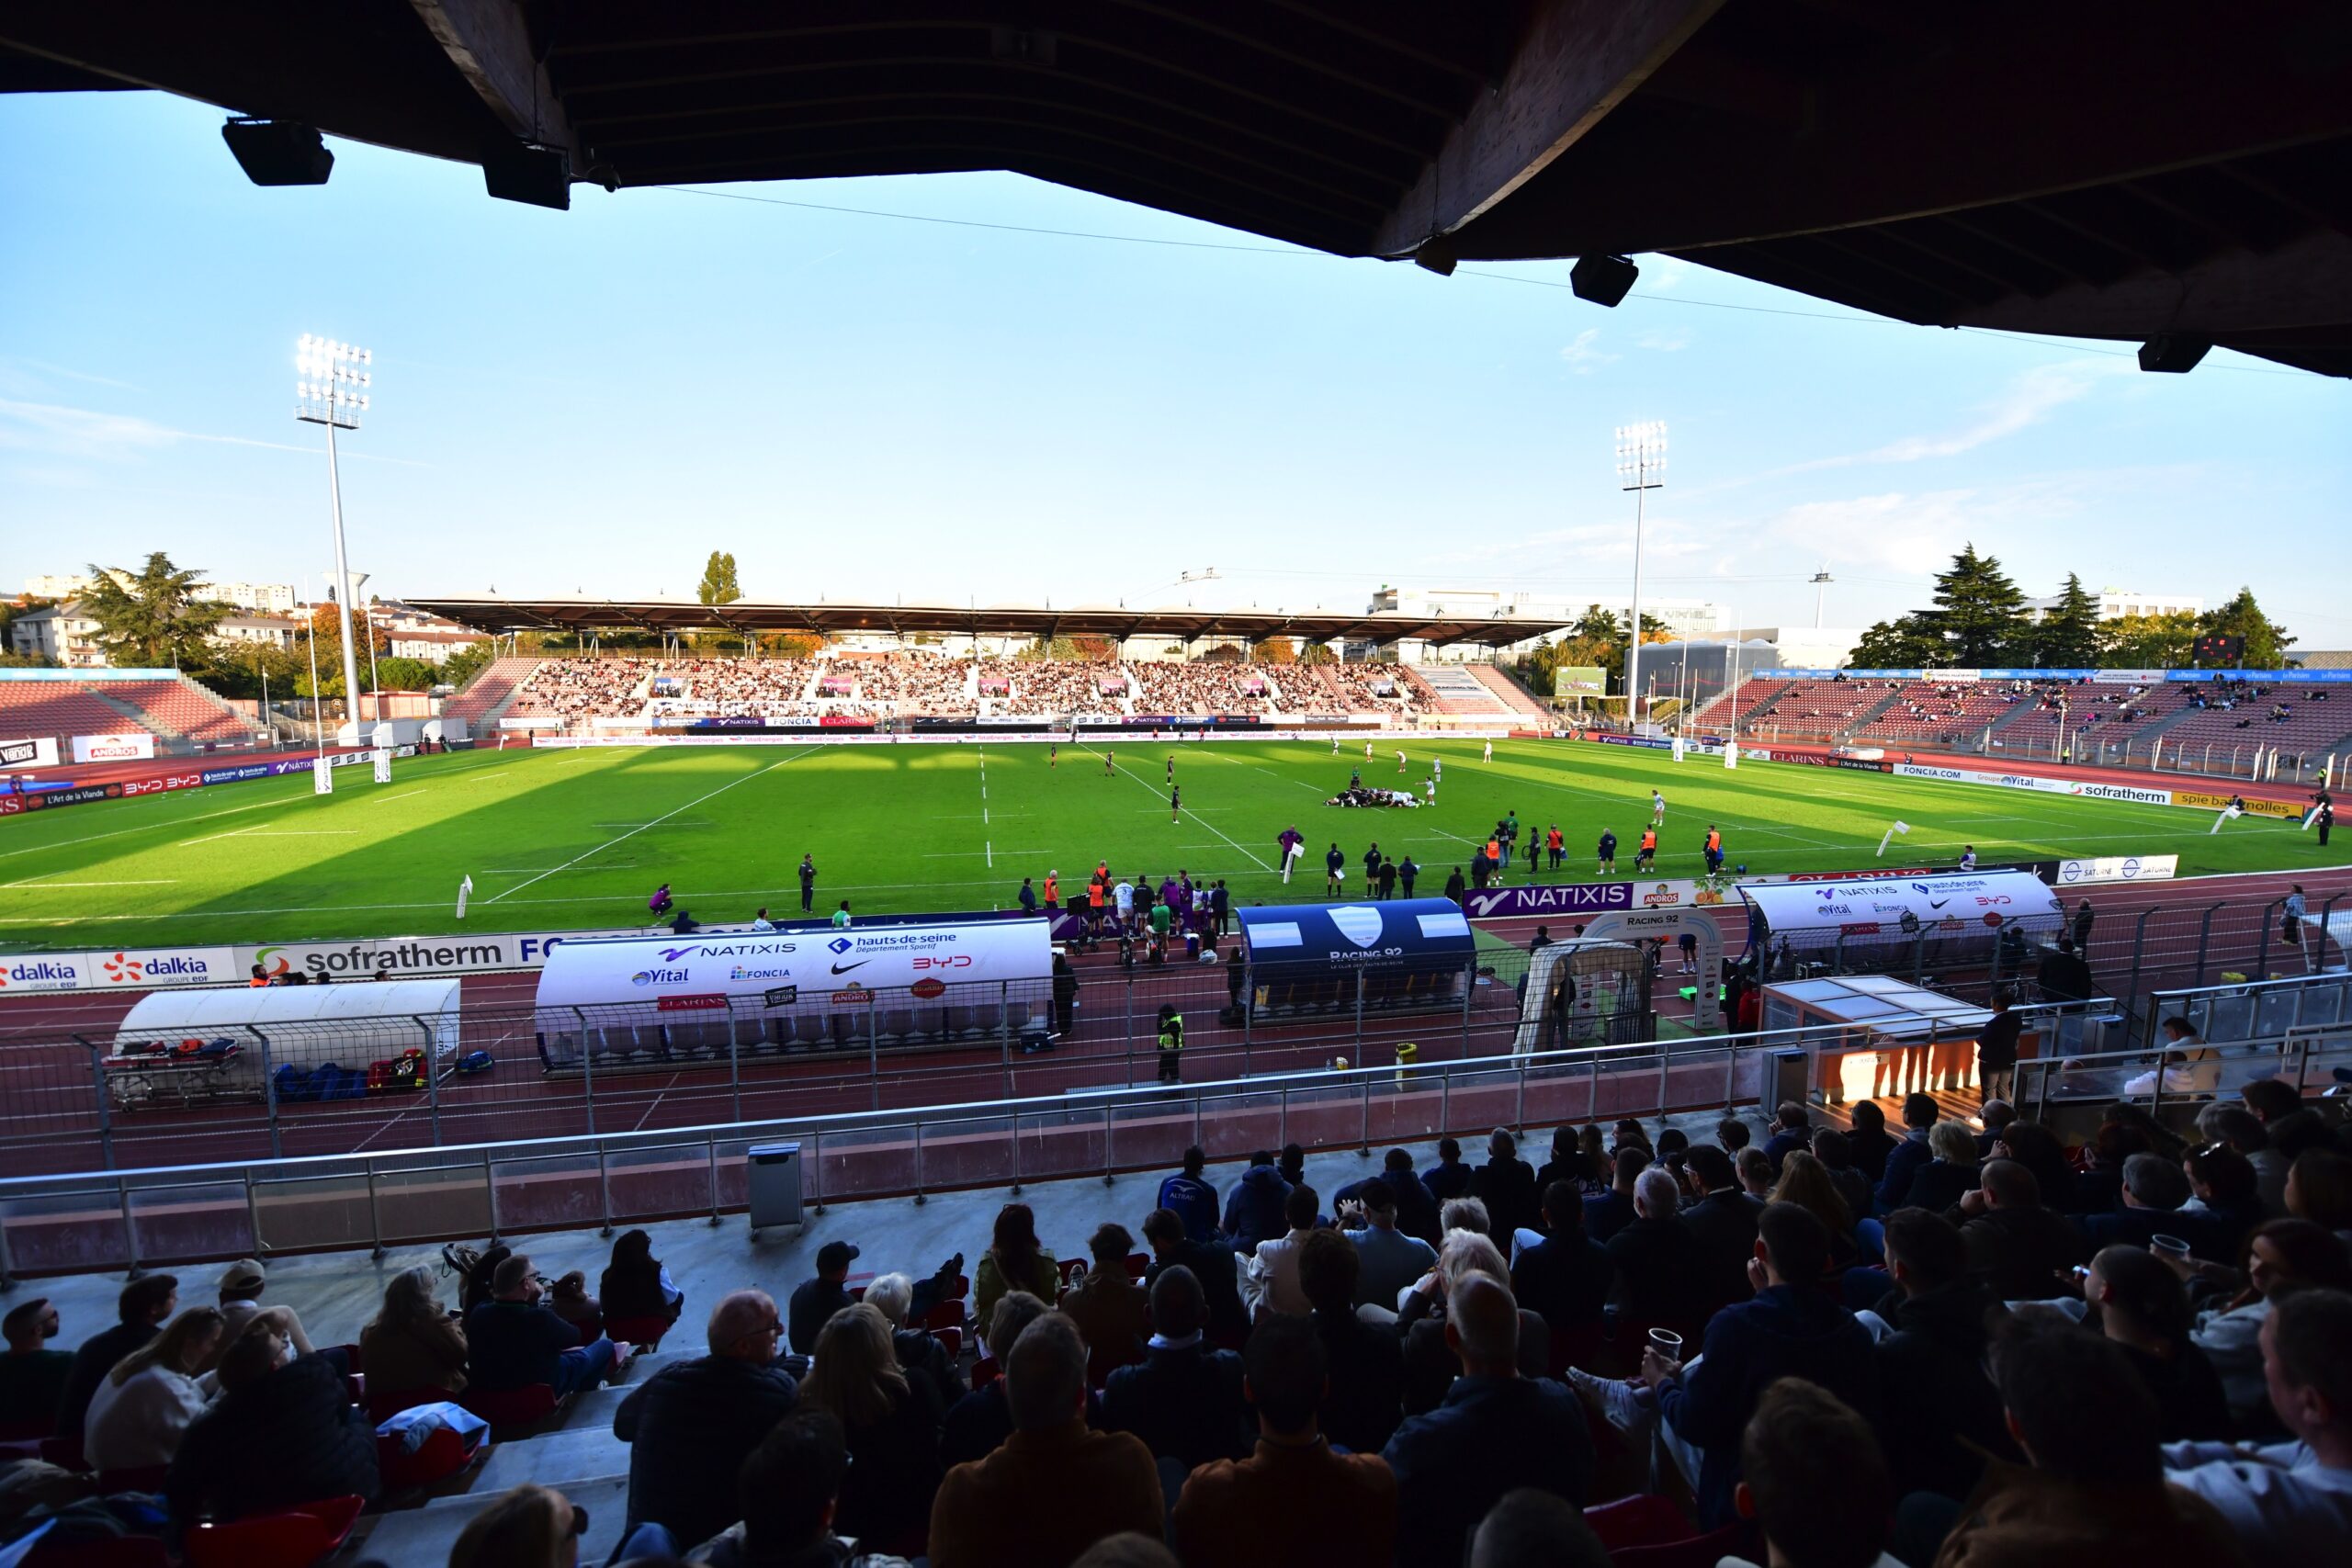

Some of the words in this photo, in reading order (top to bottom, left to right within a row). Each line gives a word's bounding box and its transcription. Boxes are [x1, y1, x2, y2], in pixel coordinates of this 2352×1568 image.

[93, 747, 137, 757] ANDROS
[1773, 753, 1825, 766] CLARINS
[288, 761, 314, 771] NATIXI
[1904, 767, 1961, 779] FONCIA.COM
[1977, 773, 2001, 783] Groupe
[2010, 776, 2034, 786] Vital
[48, 795, 64, 805] L'Art
[75, 792, 81, 800] la
[83, 790, 104, 799] Viande
[2086, 785, 2165, 803] sofratherm
[2182, 794, 2209, 805] spie
[2211, 795, 2290, 814] banolles
[2084, 868, 2111, 876] SATURNE
[1517, 885, 1625, 908] NATIXIS
[1838, 886, 1897, 897] NATIXIS
[1645, 894, 1678, 904] ANDROS
[1826, 904, 1851, 915] Vital
[1627, 917, 1664, 925] RACING
[700, 942, 797, 957] NATIXIS
[856, 944, 908, 953] Département
[305, 942, 502, 972] sofratherm
[11, 963, 75, 981] dalkia
[145, 957, 207, 975] dalkia
[650, 968, 689, 982] Vital
[747, 969, 790, 979] FONCIA
[29, 982, 57, 990] GROUPE
